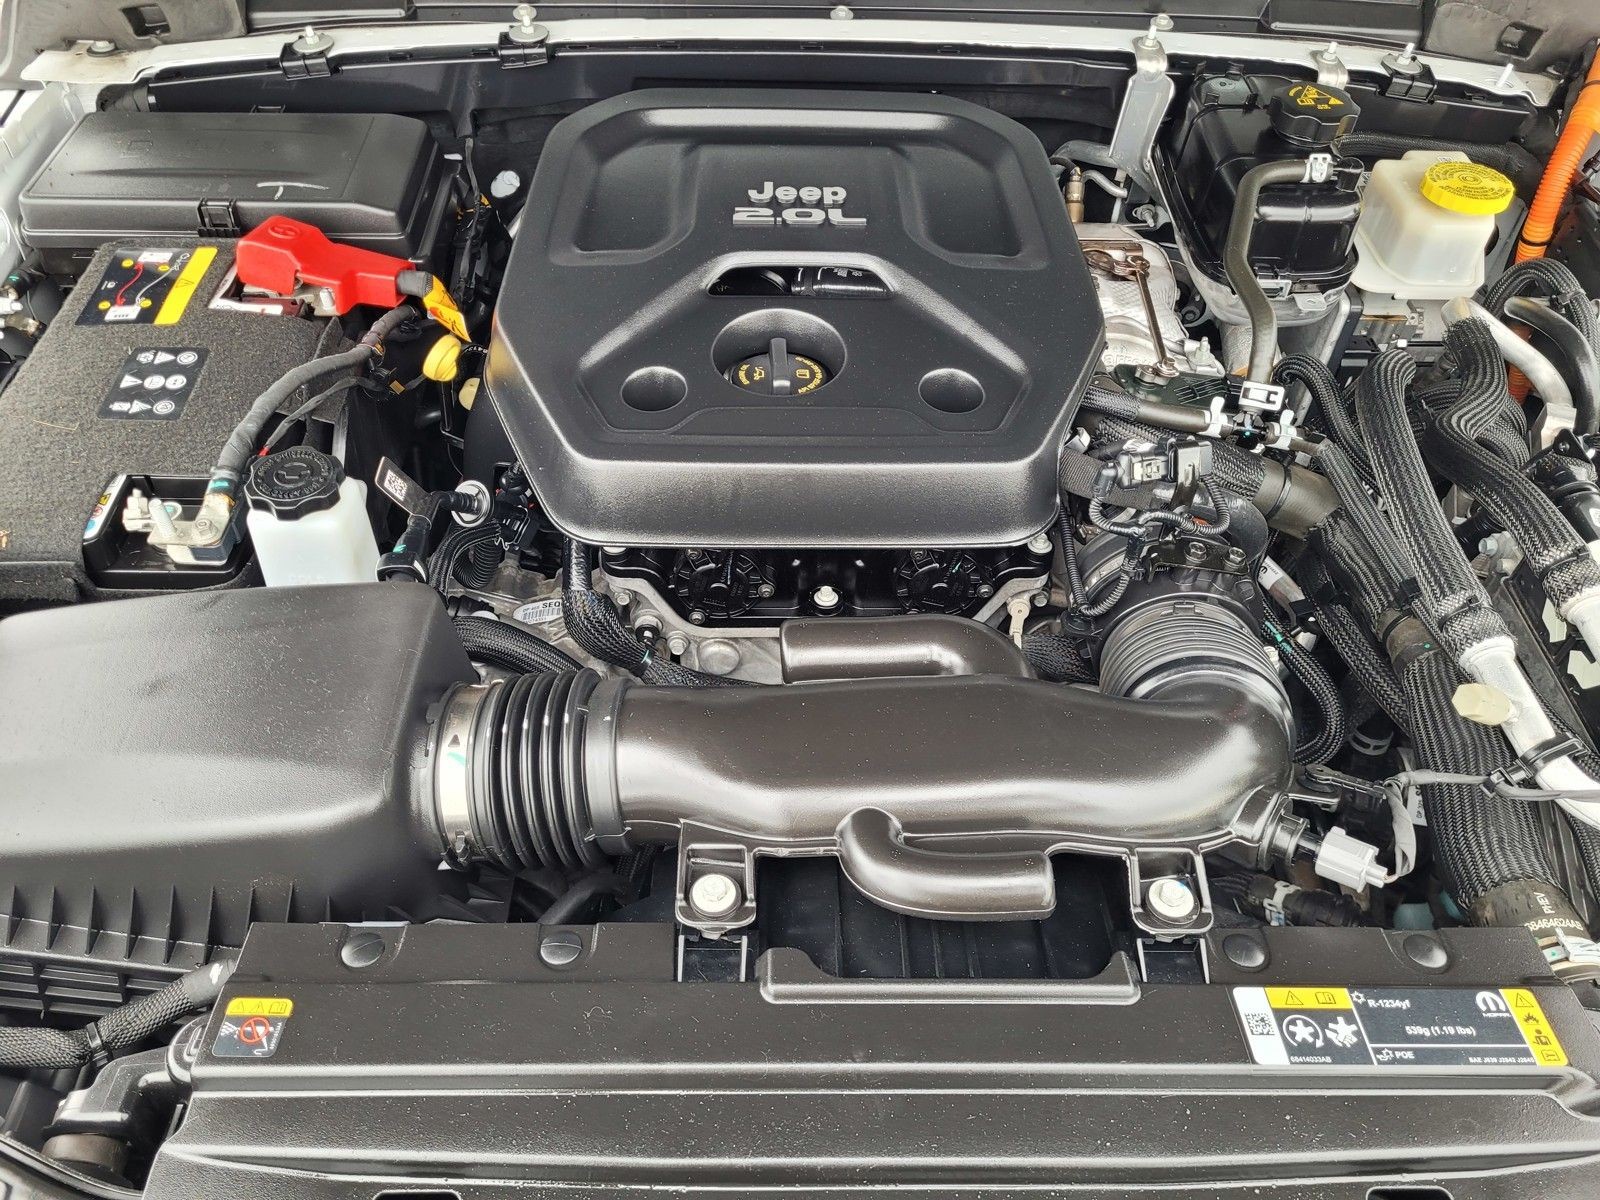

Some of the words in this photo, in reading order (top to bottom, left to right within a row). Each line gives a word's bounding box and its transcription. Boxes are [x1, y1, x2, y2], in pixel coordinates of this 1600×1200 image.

[747, 181, 847, 207] Jeep
[732, 206, 867, 225] 2.0L
[1367, 999, 1411, 1010] R-1234yf
[1456, 1025, 1476, 1037] lbs)
[1394, 1051, 1415, 1060] POE
